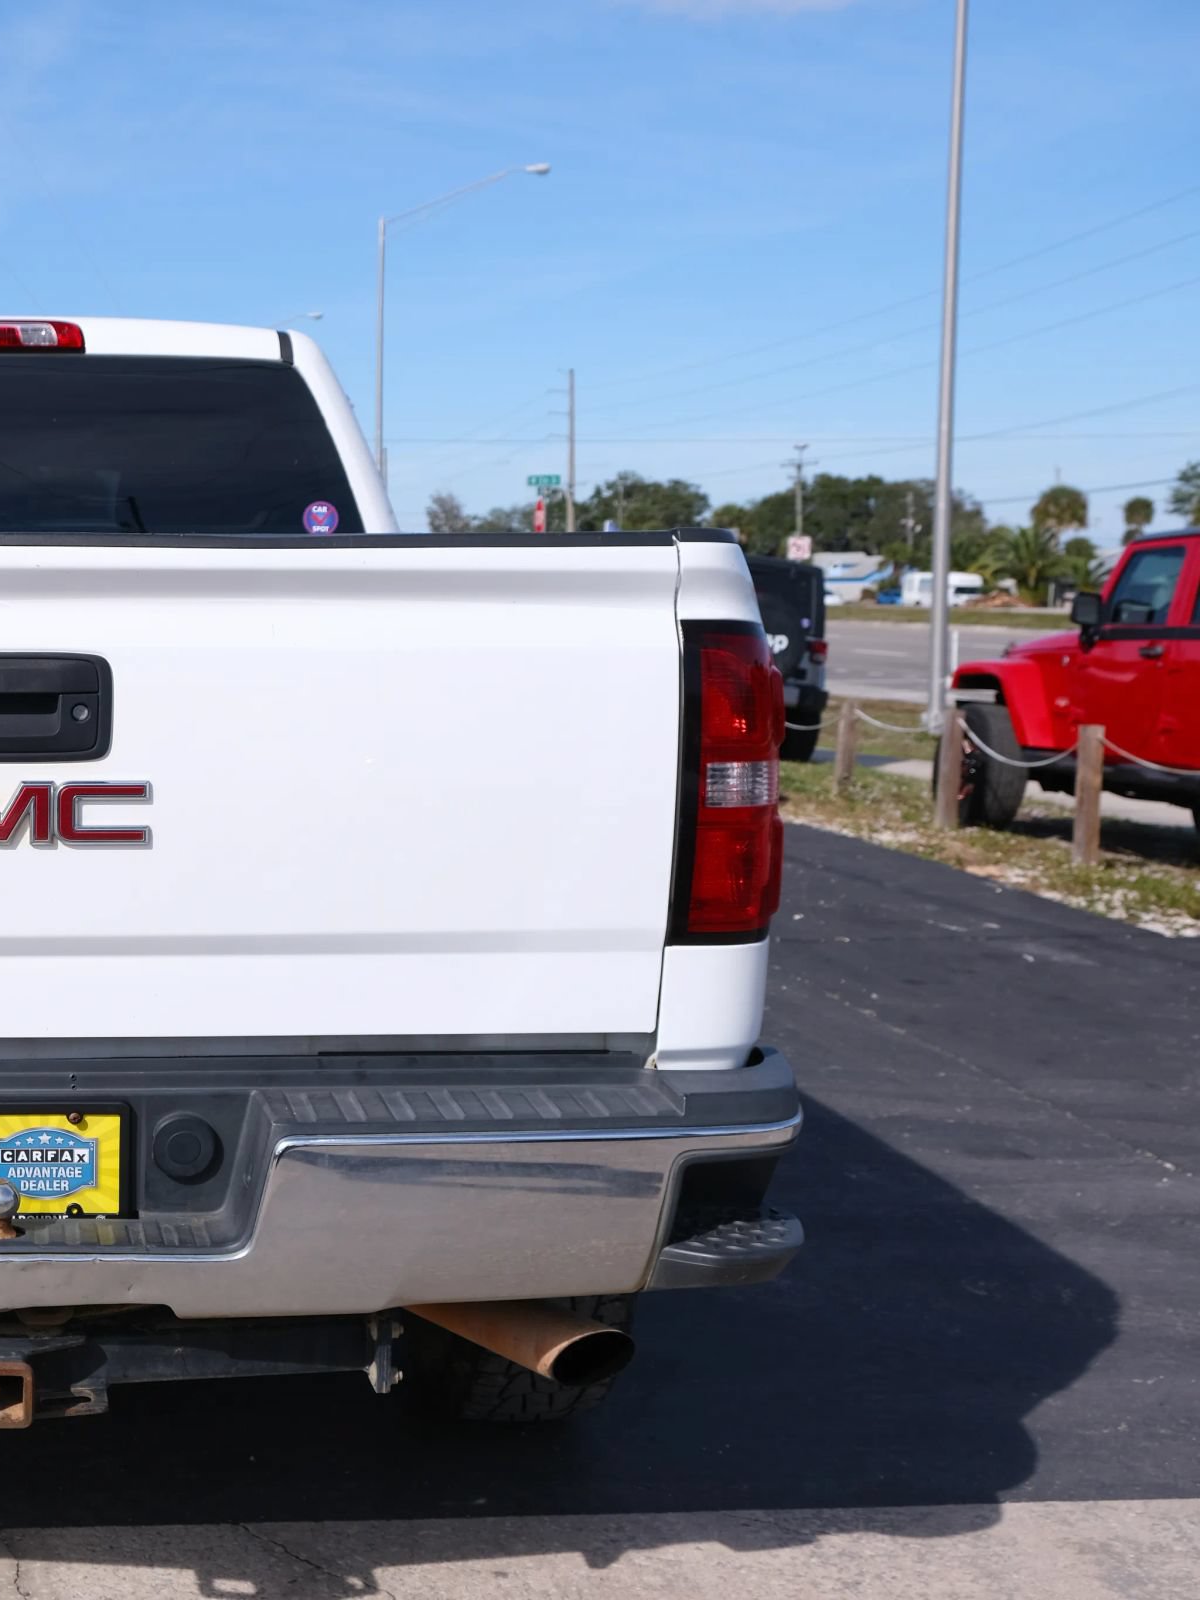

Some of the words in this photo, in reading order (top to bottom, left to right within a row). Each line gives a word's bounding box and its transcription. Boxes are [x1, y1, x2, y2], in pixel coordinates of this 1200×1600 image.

[1, 1149, 89, 1164] CARFAX
[7, 1166, 83, 1179] ADVANTAGE
[20, 1180, 69, 1191] DEALER
